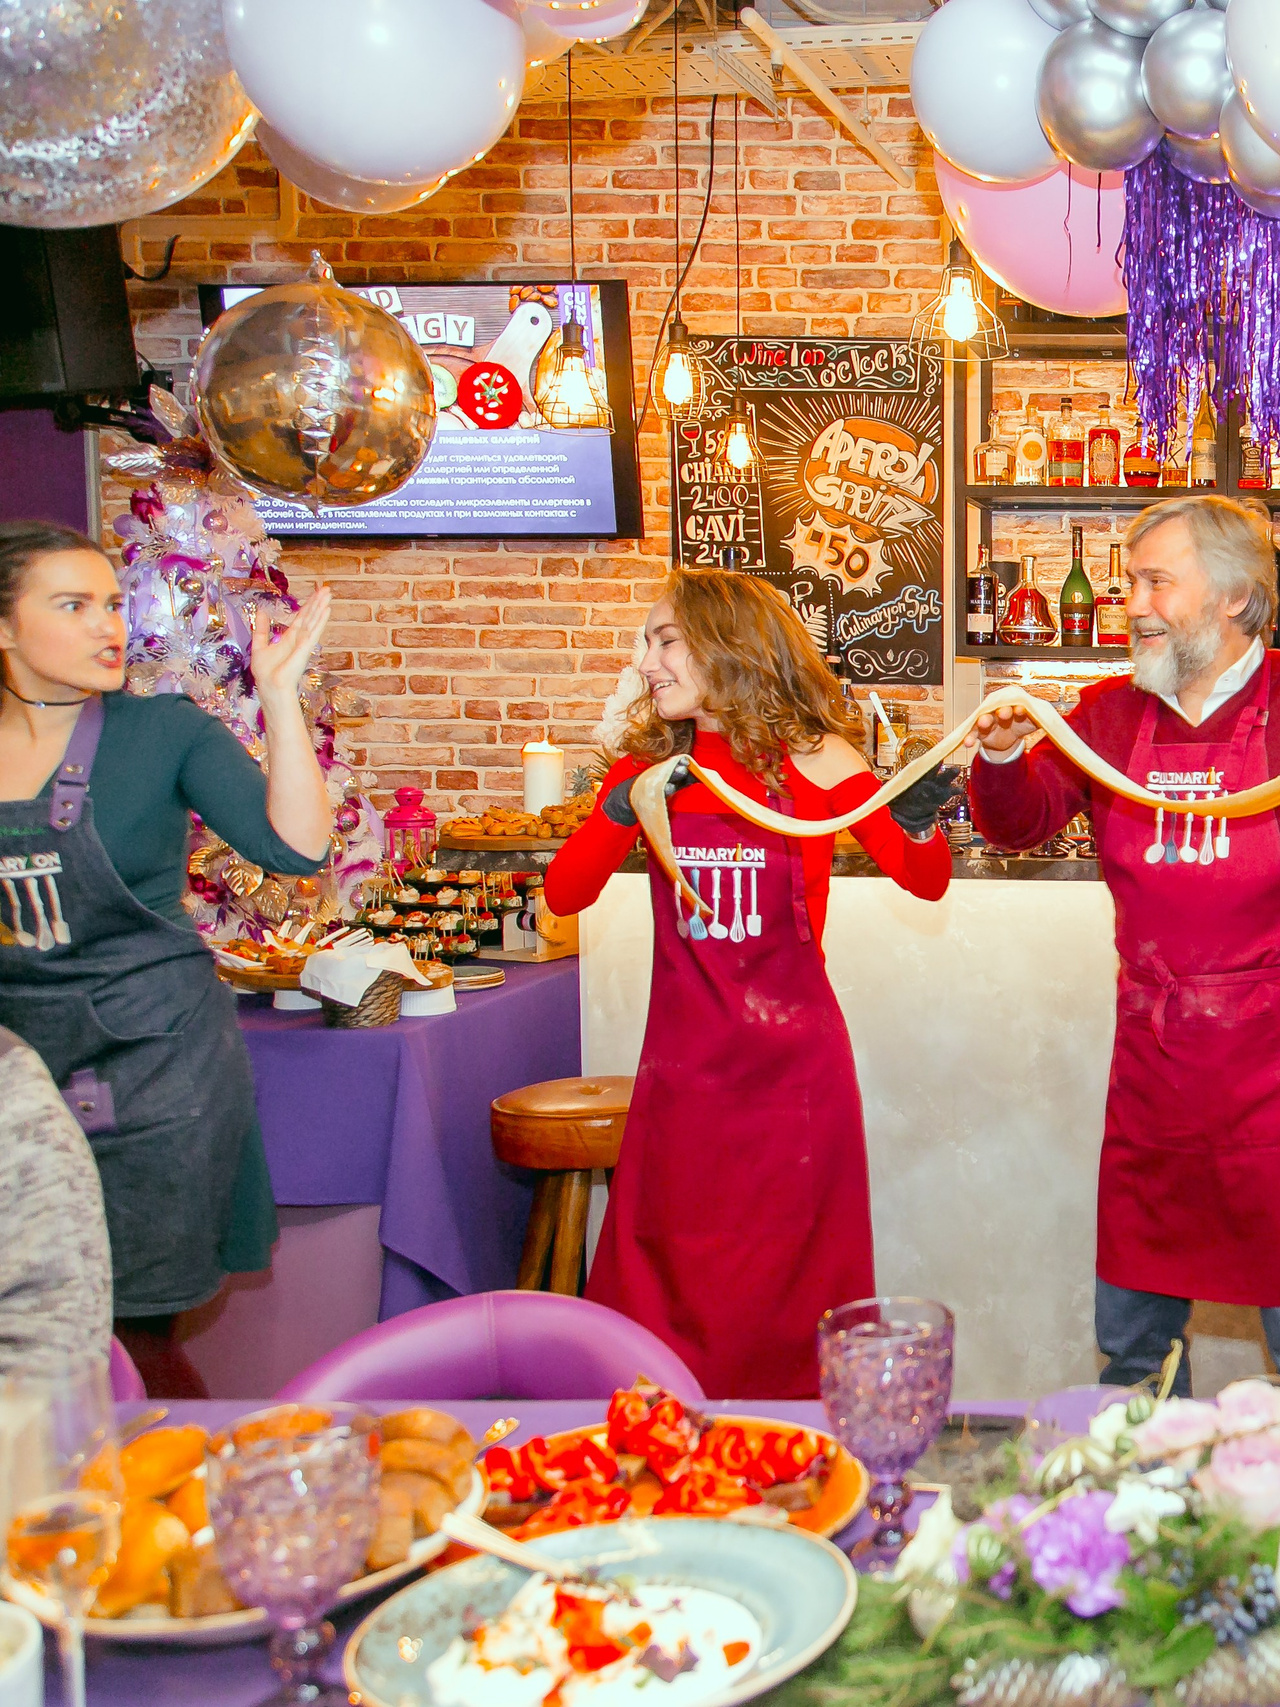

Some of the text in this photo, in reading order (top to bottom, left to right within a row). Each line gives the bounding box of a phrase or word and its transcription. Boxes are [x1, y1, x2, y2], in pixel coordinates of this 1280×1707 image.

[730, 342, 787, 366] Wine
[800, 347, 826, 366] on
[438, 435, 489, 445] пищевых
[490, 434, 541, 446] аллергий
[449, 454, 502, 464] стремиться
[503, 454, 568, 464] удовлетворить
[810, 418, 935, 499] APEROL
[424, 465, 473, 475] аллергией
[474, 466, 491, 474] или
[492, 464, 560, 475] определенной
[451, 476, 517, 486] гарантировать
[518, 475, 576, 485] абсолютной
[409, 499, 454, 508] отследить
[456, 498, 531, 508] микроэлементы
[532, 498, 585, 508] аллергенов
[690, 484, 749, 510] 2400
[813, 473, 936, 536] SPRITZ
[334, 510, 398, 519] поставляемых
[398, 510, 445, 519] продуктах
[453, 511, 472, 519] при
[473, 510, 523, 519] возможных
[524, 510, 569, 518] контактах
[695, 543, 750, 567] 240
